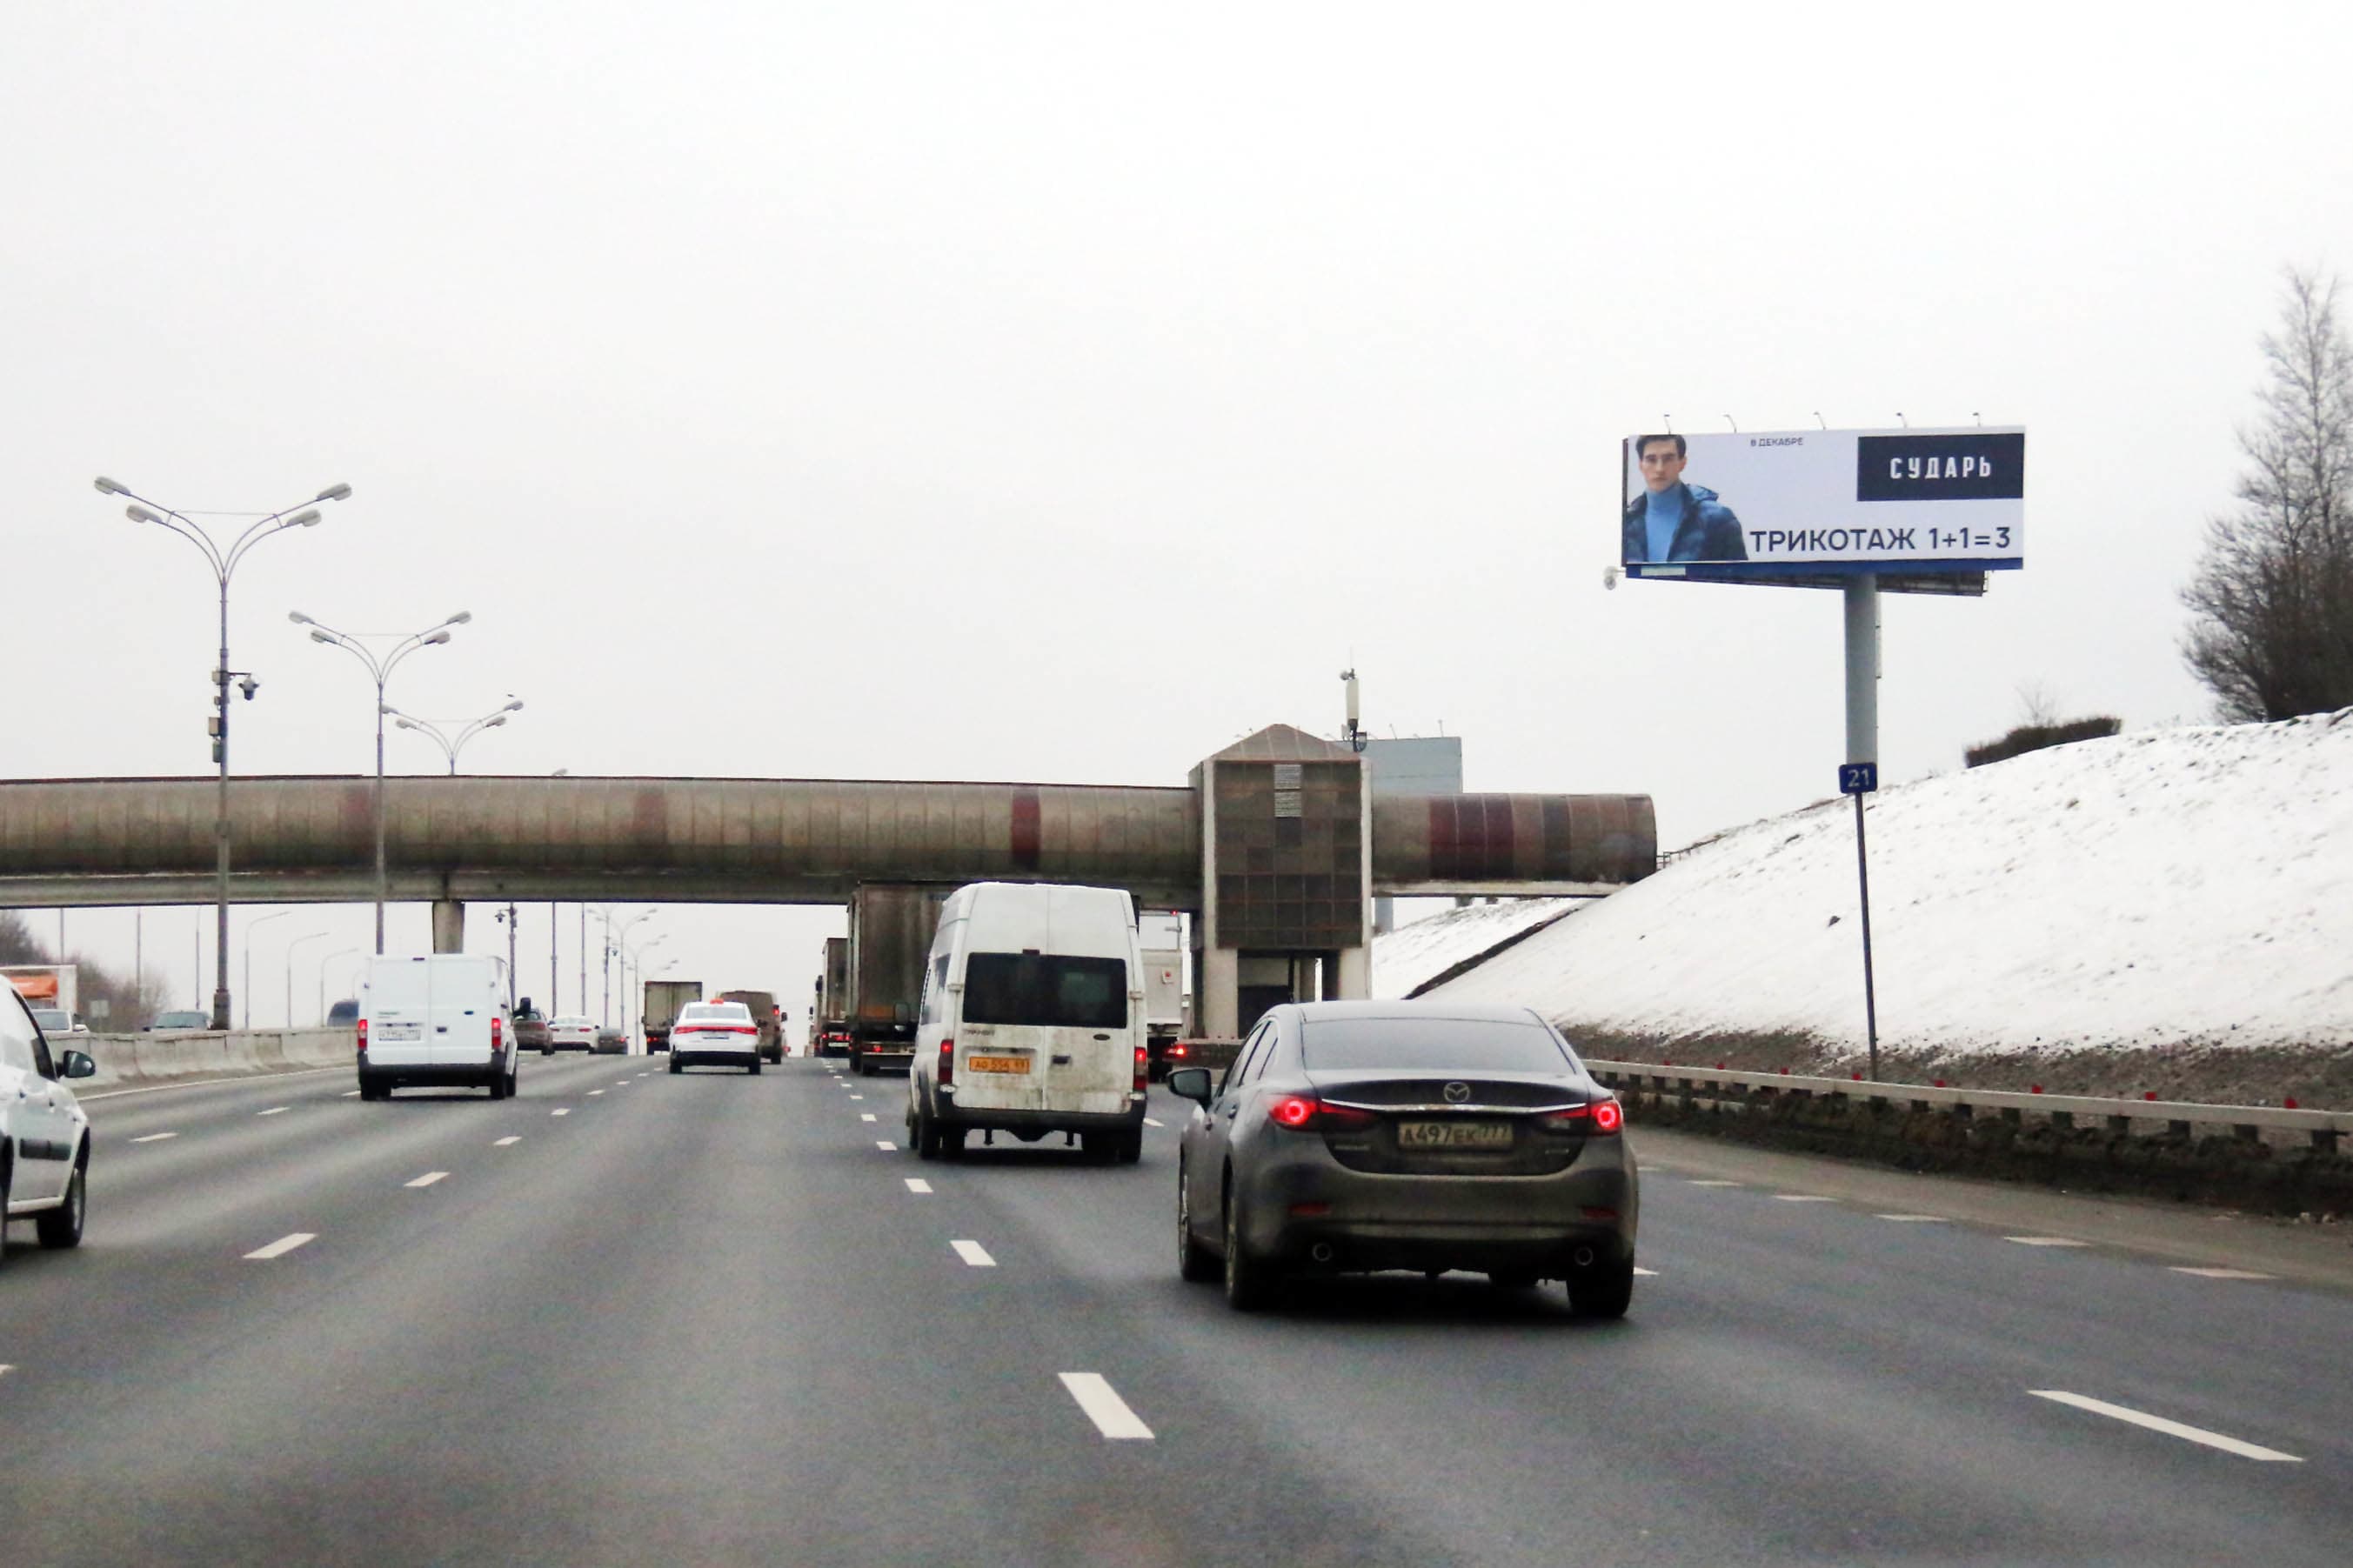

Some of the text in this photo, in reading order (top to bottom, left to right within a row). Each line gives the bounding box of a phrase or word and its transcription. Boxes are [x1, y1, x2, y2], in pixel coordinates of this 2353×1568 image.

[1759, 437, 1803, 447] ДЕКАБРЕ
[1889, 457, 1991, 479] СУДАРЬ
[1749, 527, 2011, 552] ТРИКОТАЖ 1+1=3
[1848, 768, 1869, 787] 21
